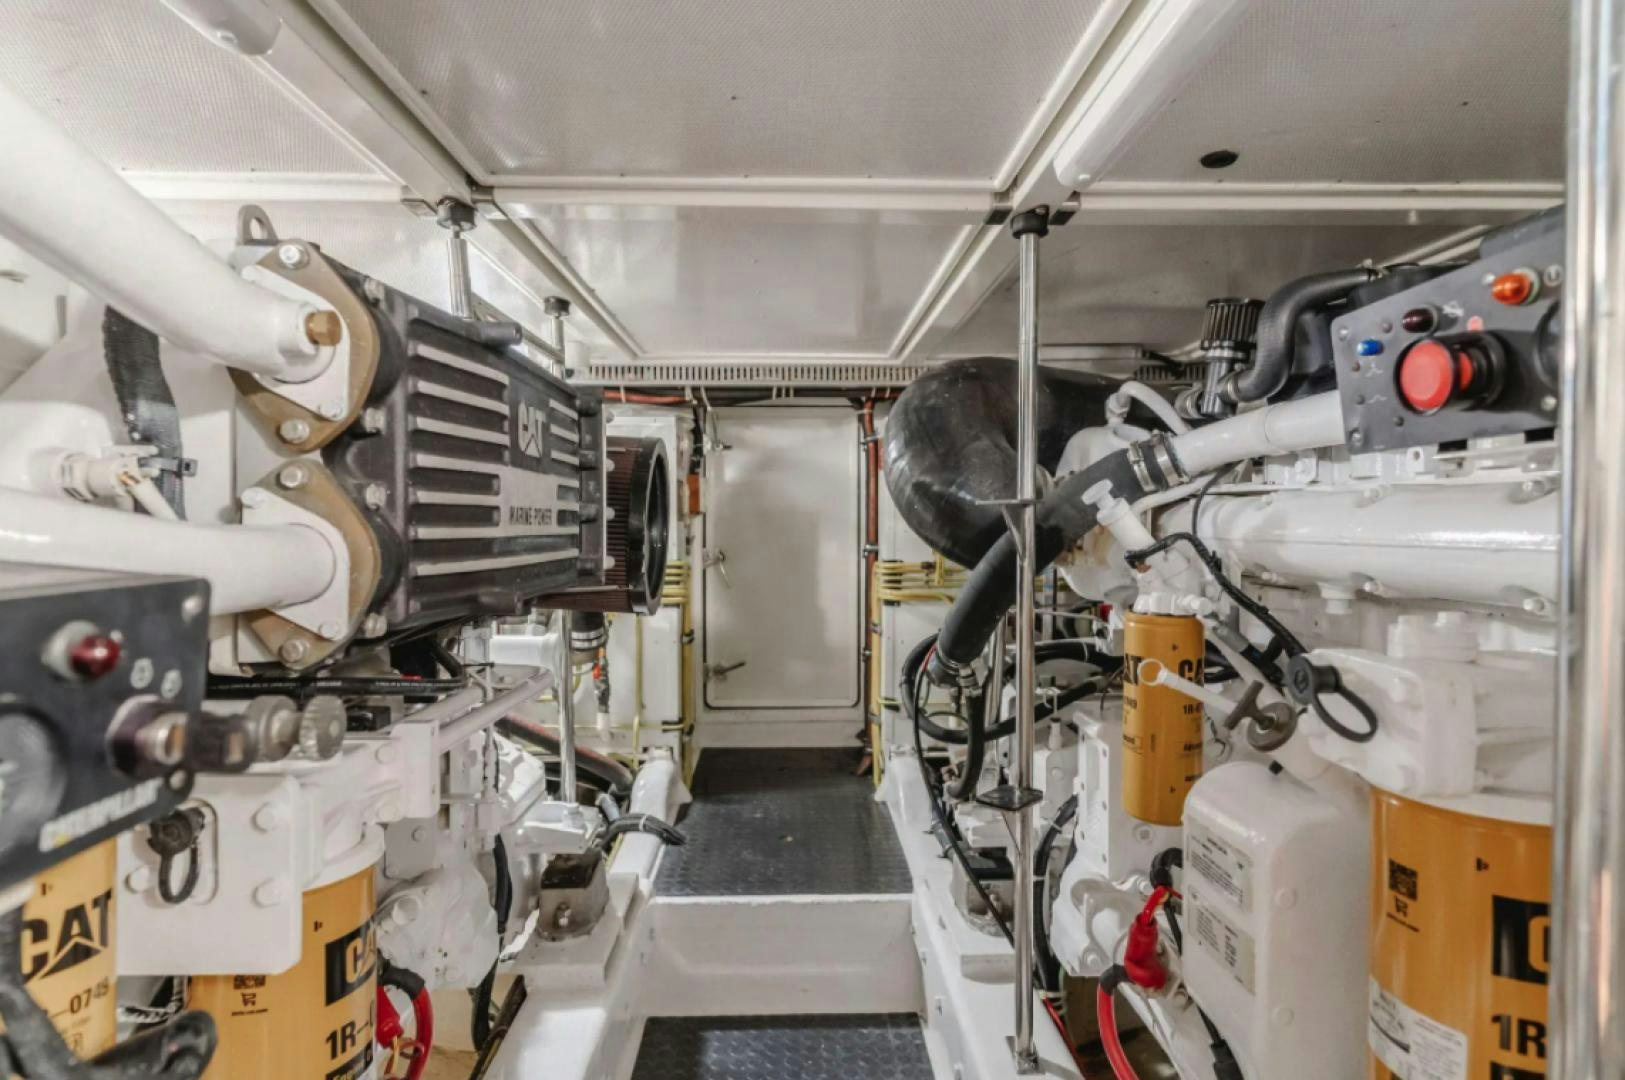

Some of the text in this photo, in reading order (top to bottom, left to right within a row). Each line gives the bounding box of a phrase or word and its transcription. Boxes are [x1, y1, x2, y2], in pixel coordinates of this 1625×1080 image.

[517, 398, 546, 458] CAT
[509, 505, 532, 526] MARINE
[23, 888, 113, 984] CAT
